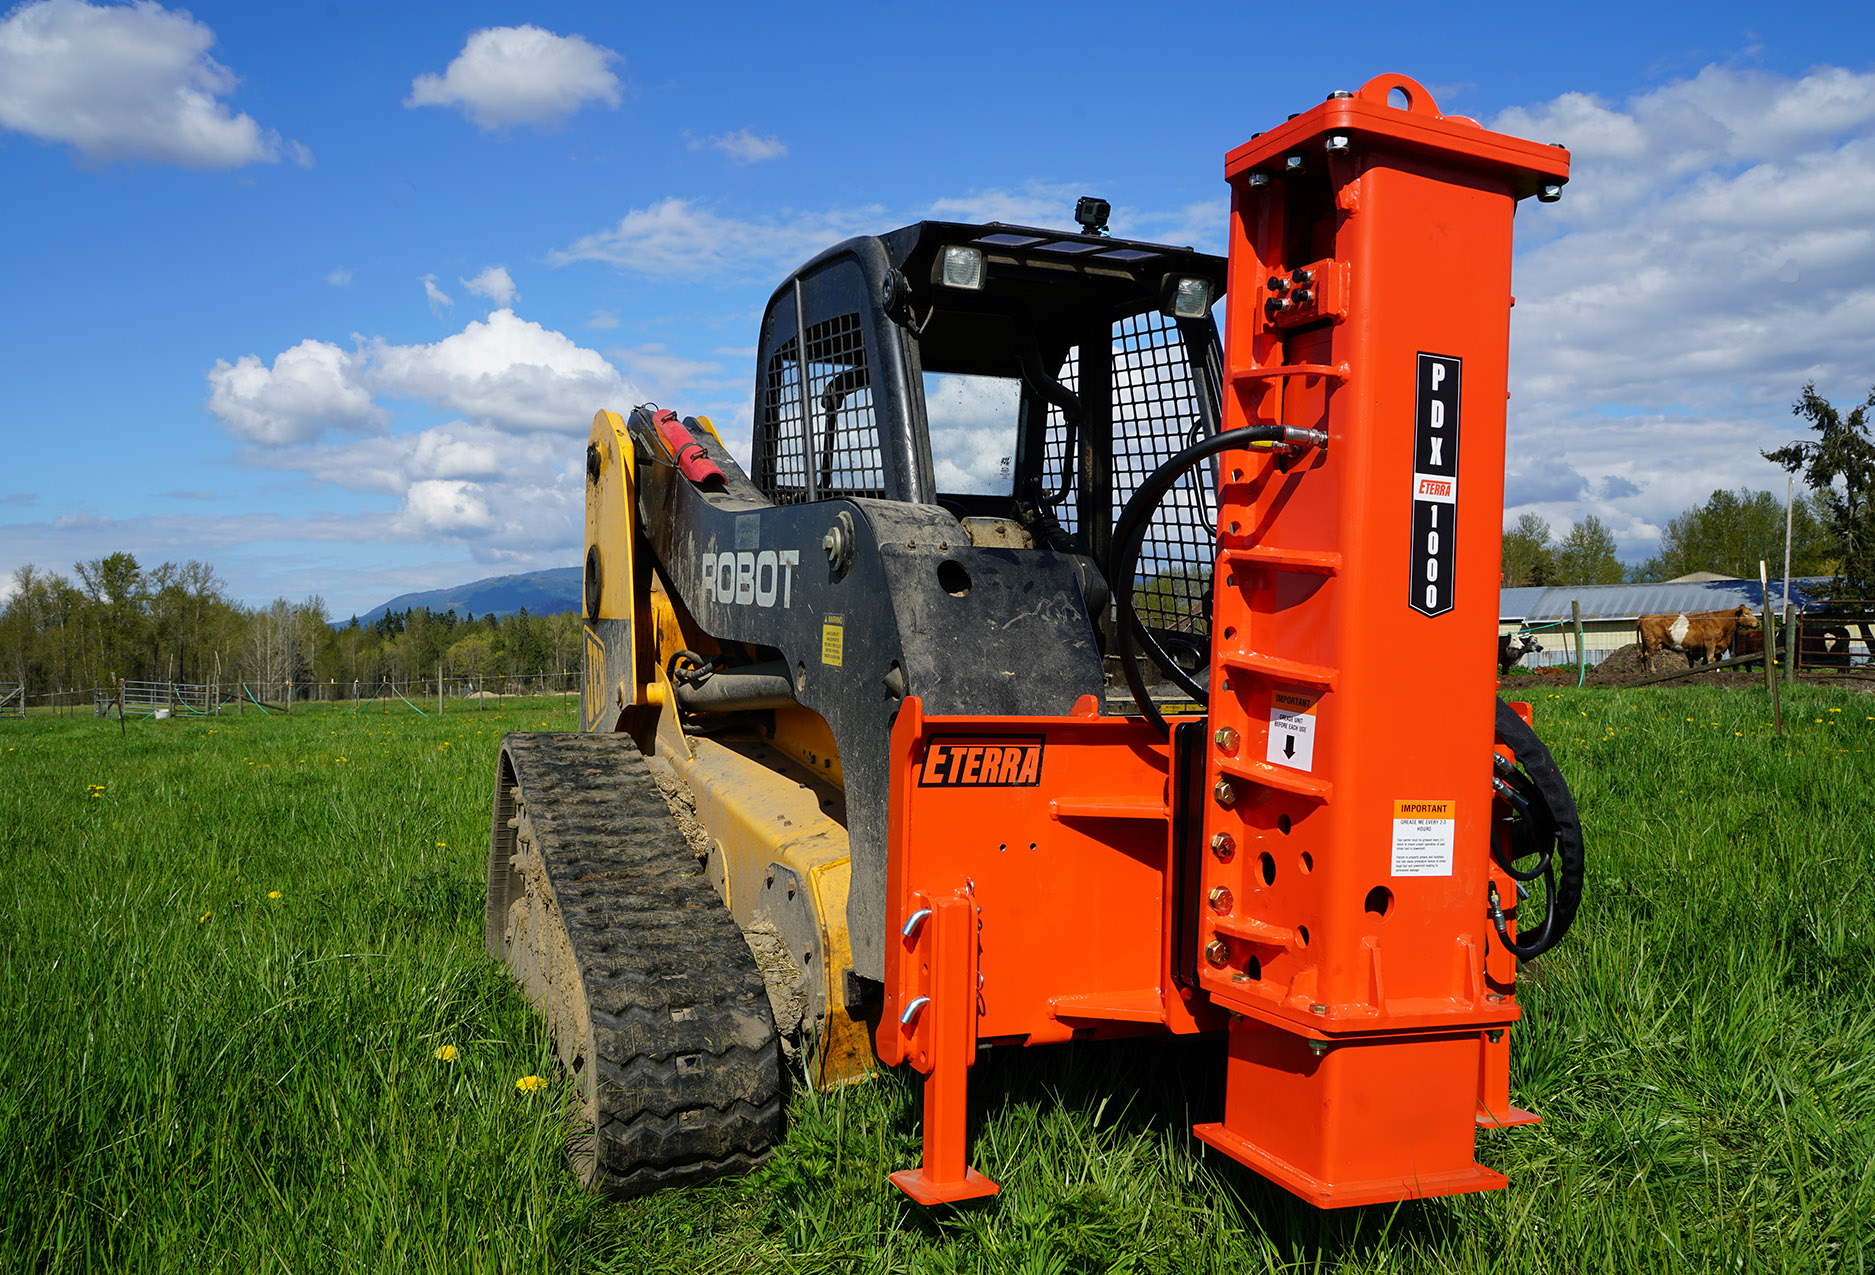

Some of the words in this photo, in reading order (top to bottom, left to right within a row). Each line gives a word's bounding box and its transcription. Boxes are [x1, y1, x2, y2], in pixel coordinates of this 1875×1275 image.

[1429, 362, 1446, 466] PDX
[1418, 479, 1452, 497] ETERRA
[1425, 504, 1440, 609] 1000
[702, 549, 800, 609] ROBOT
[586, 637, 606, 723] JCB
[1275, 694, 1311, 707] IMPORTANT
[1274, 720, 1288, 730] BEFORE
[1299, 726, 1307, 734] USE
[921, 744, 1041, 784] ETERRA
[1401, 804, 1448, 813] IMPORTANT
